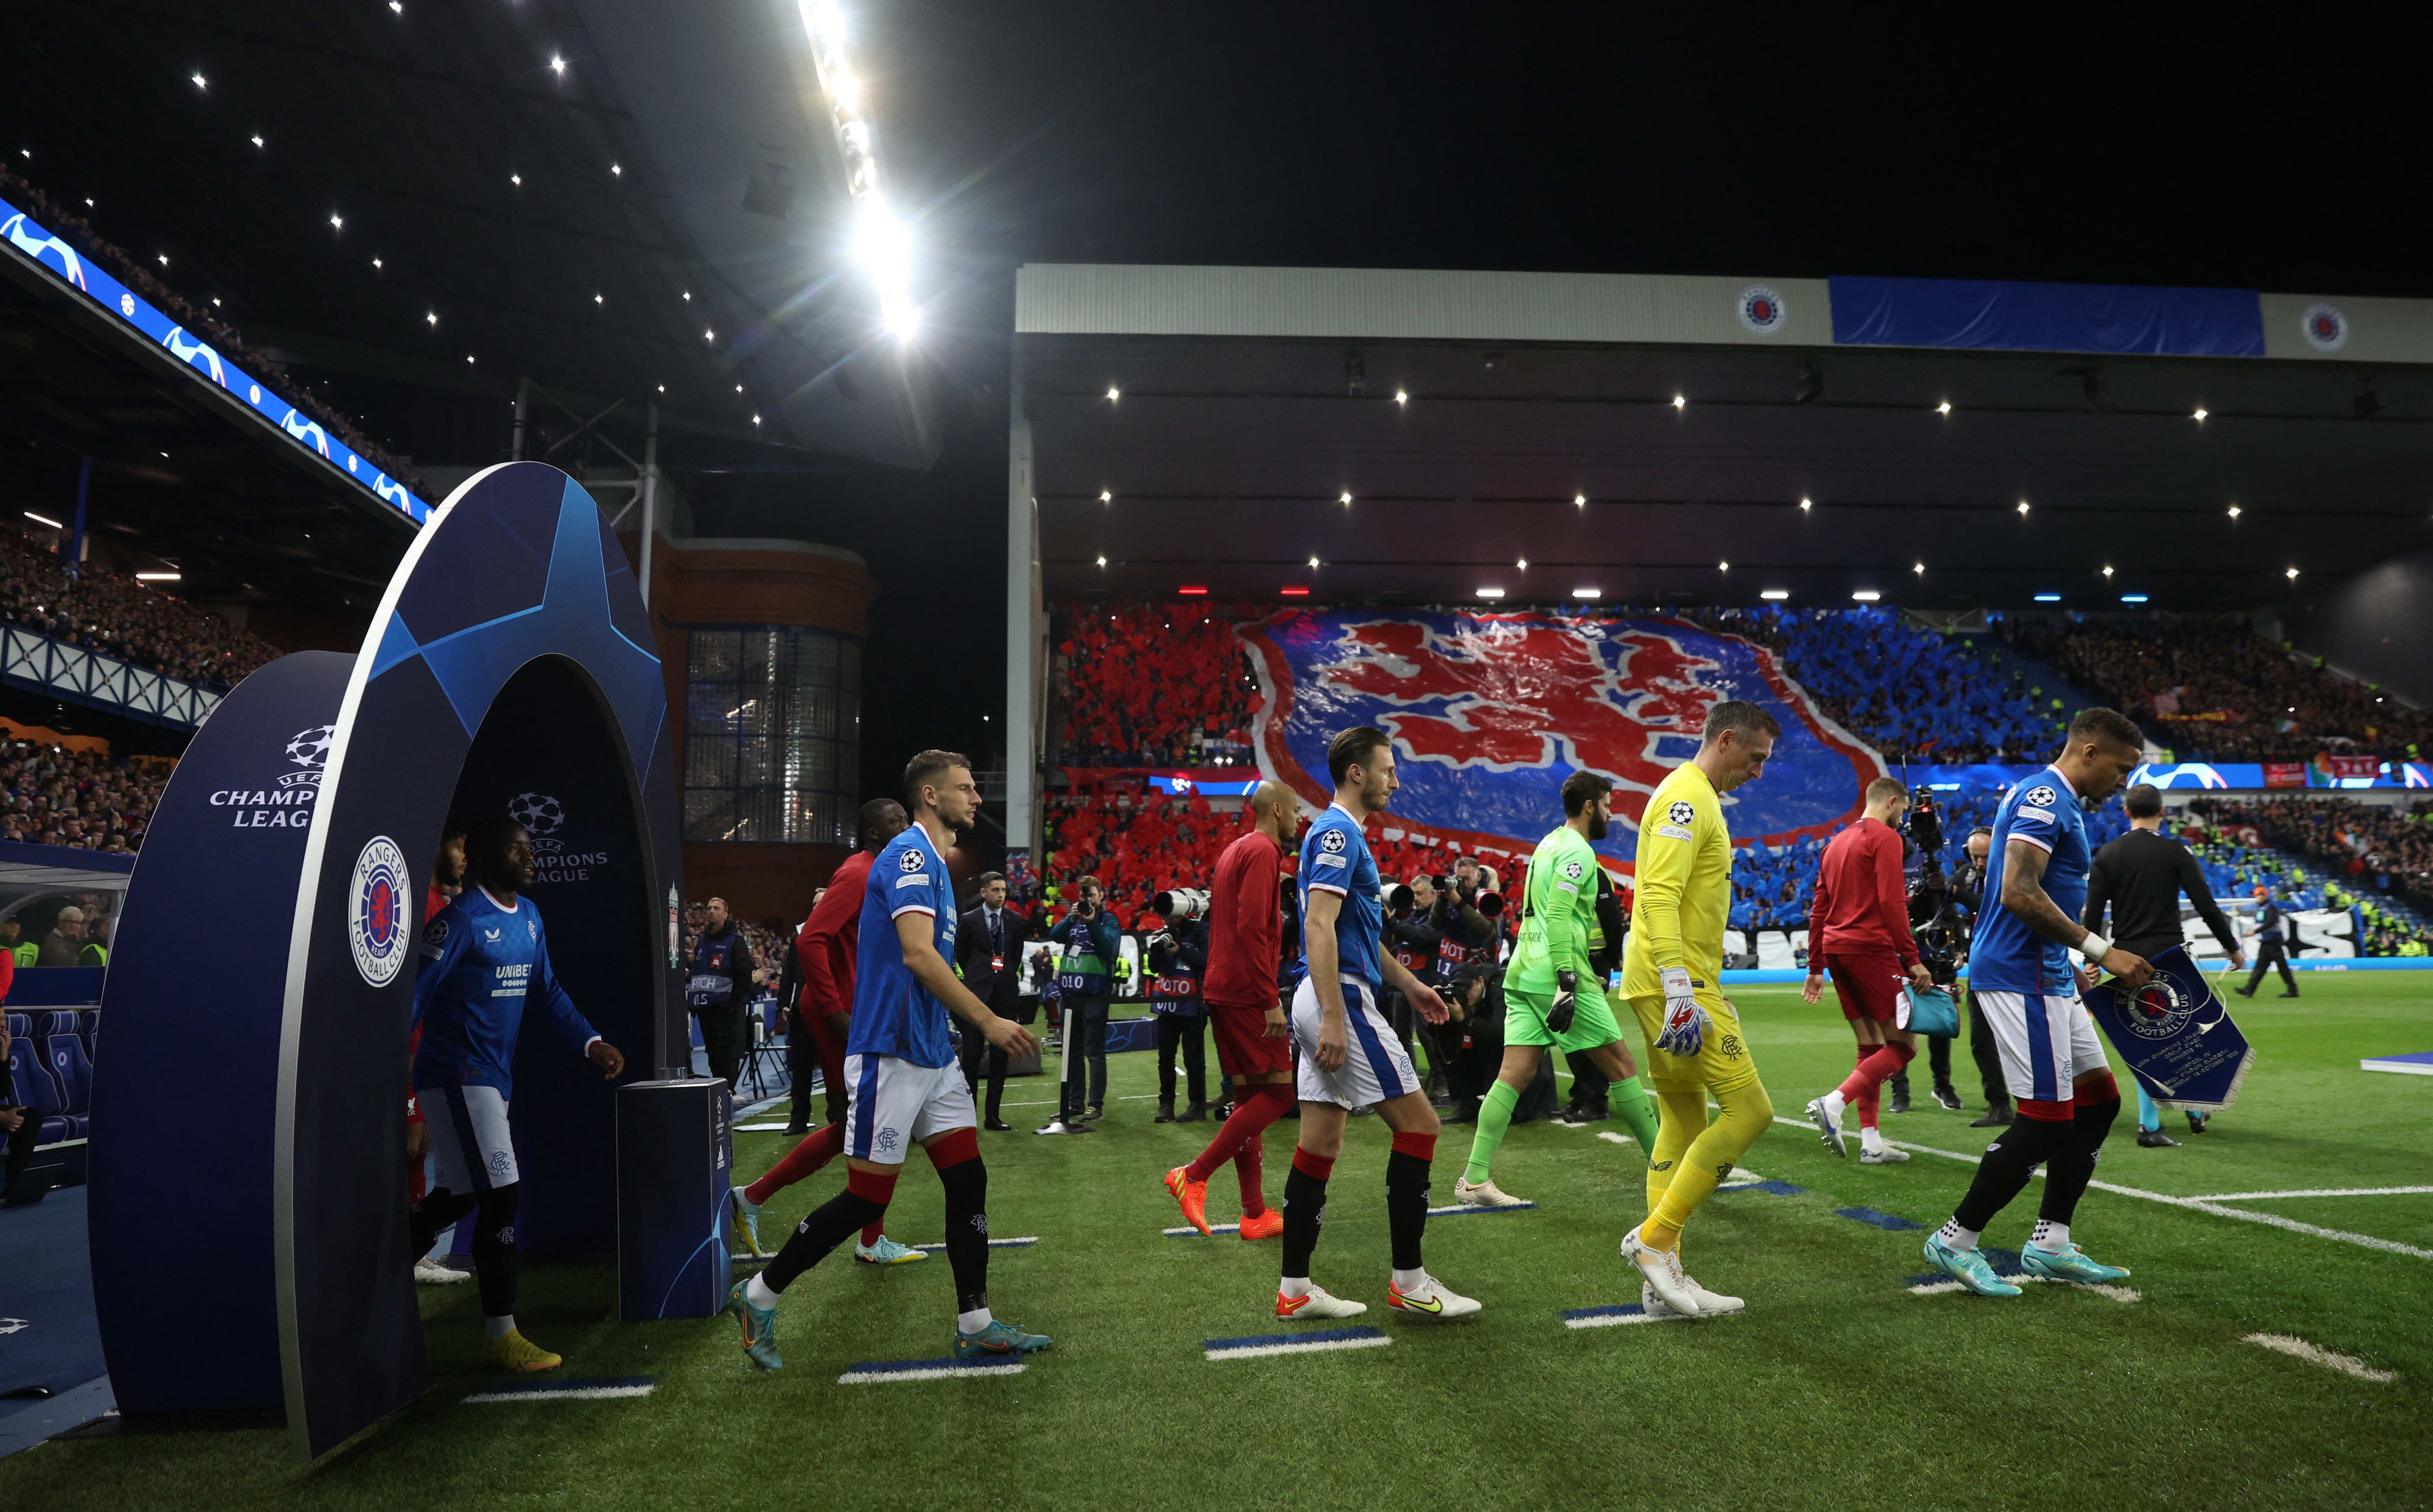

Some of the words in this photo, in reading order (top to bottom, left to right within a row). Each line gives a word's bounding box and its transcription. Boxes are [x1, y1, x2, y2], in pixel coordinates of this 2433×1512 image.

[279, 774, 322, 786] UEF
[210, 791, 316, 805] CHAMP
[233, 810, 309, 827] LEAG
[532, 852, 608, 869] MPIONS
[359, 846, 406, 890] RANGERS
[531, 869, 589, 883] AGUE
[353, 920, 389, 977] FOOTBALL
[389, 929, 405, 969] CLUB
[370, 944, 387, 957] READY
[692, 977, 716, 989] PTCH
[1061, 975, 1083, 988] 010
[2130, 1020, 2183, 1036] FOOTBALL
